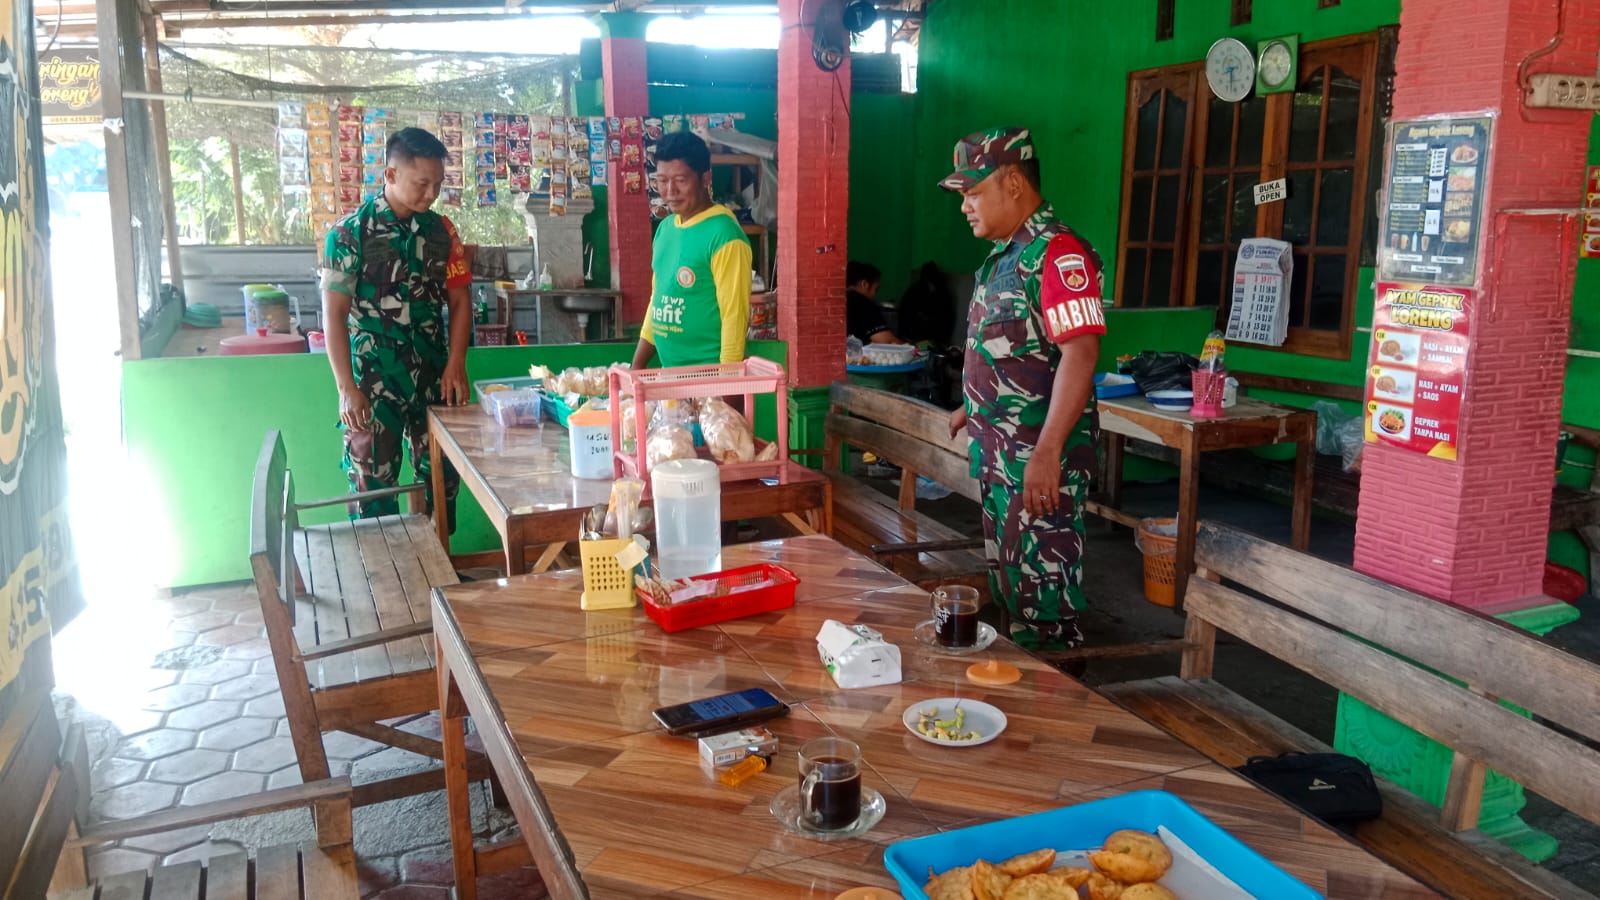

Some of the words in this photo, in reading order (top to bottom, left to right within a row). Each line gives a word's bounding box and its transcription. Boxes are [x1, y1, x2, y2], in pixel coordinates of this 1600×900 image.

[1259, 182, 1280, 193] BUKA
[1260, 191, 1281, 202] OPEN
[1386, 289, 1417, 305] AYAM
[1418, 292, 1463, 310] GEPREK
[1391, 305, 1453, 330] LORENG
[1419, 379, 1434, 390] NASI
[1439, 383, 1459, 394] AYAM
[1434, 431, 1450, 442] NASI
